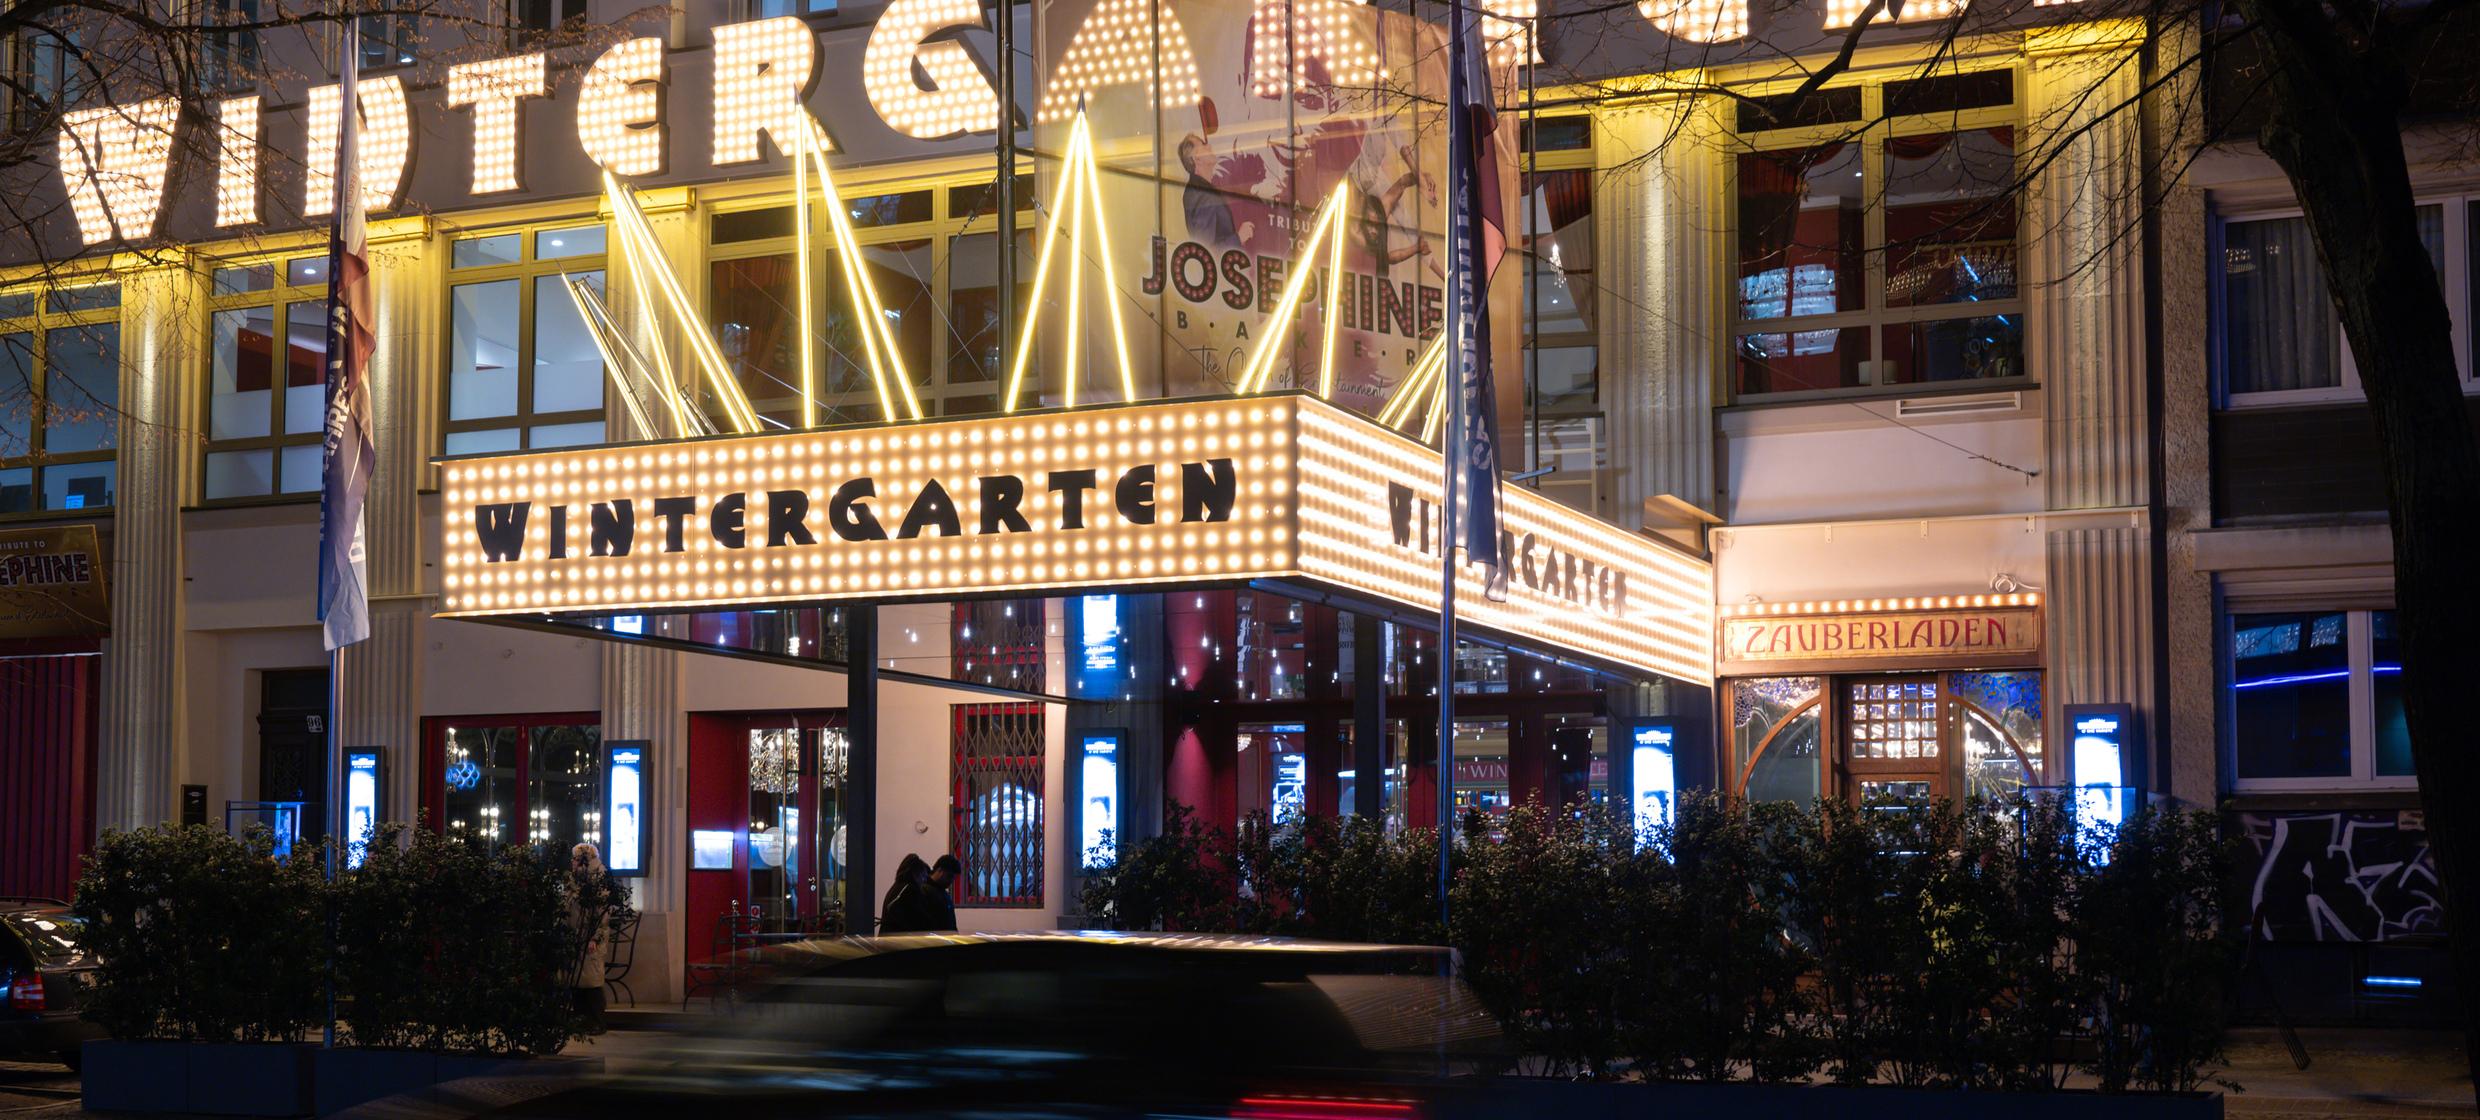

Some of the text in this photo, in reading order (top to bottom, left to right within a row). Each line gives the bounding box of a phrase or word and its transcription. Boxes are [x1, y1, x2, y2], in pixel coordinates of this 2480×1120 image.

[58, 0, 1970, 246] WINTERGAR
[1268, 213, 1320, 233] TRIBU
[1289, 238, 1306, 251] TO
[1142, 235, 1445, 341] JOSEPHINE
[1188, 344, 1221, 382] The
[475, 458, 1236, 563] WINTERGARTEN
[1388, 480, 1626, 617] WIRGARTEN
[1745, 616, 2008, 653] ZAUBERLADEN
[308, 717, 321, 728] 96
